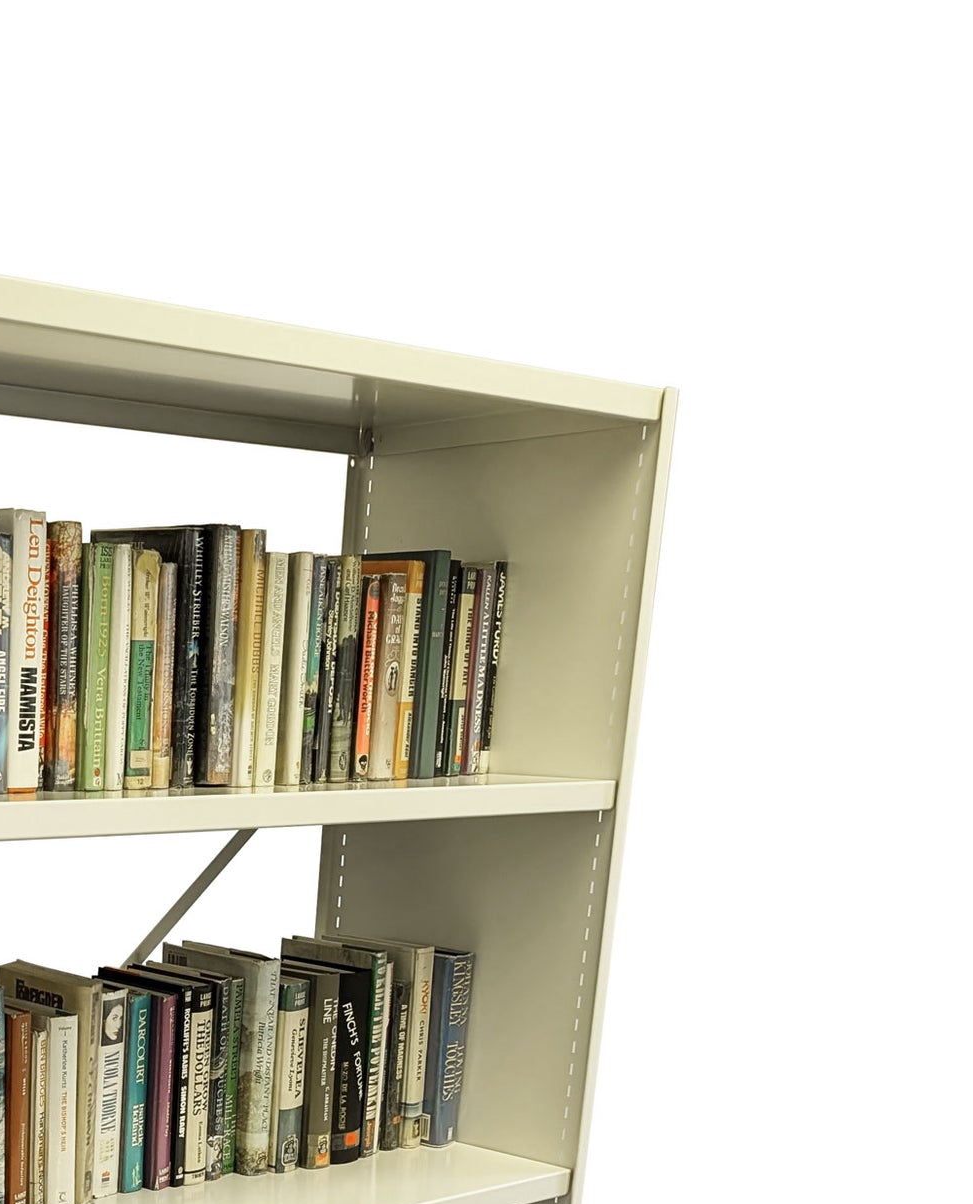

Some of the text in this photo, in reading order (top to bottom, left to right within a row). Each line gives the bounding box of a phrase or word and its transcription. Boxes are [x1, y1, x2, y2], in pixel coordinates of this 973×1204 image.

[3, 553, 11, 615] ANDREW
[23, 518, 44, 660] Len Deighton
[61, 585, 70, 629] DAUGHTER
[98, 575, 111, 657] Born 1925
[191, 536, 204, 638] WHITLEY STRIEBER
[271, 558, 285, 657] MEN AND ANGELS
[495, 572, 506, 618] JAMES
[60, 647, 68, 666] THE
[68, 584, 80, 697] PHYLLIS WHITNEY
[219, 608, 230, 646] WATSON
[474, 575, 492, 733] KALLEN LITTLE MADNESS
[361, 611, 374, 713] Michael Butterworth
[18, 667, 38, 752] MAMISTA
[92, 668, 107, 768] Vera Brittain
[136, 680, 144, 720] Testament
[188, 688, 198, 730] FORBIDDEN
[265, 664, 280, 746] MARY GORDON
[230, 983, 243, 1081] PAMELA STREET
[322, 998, 332, 1024] LINE
[342, 1002, 359, 1045] FINCH'S
[442, 960, 466, 1101] KINGSLEY TOUCHES
[135, 1008, 146, 1085] DARCOURT
[181, 1055, 189, 1079] BABIES
[193, 1019, 206, 1116] THE DOLLARS
[254, 1021, 266, 1084] Patricia Wright
[287, 1029, 297, 1092] Genevieve Lyons
[294, 1018, 305, 1099] SLIEVELEA
[396, 1042, 405, 1080] MADNESS
[416, 1049, 424, 1082] PARKER
[100, 1051, 120, 1133] NICOLA THORNE
[179, 1086, 187, 1114] SIMON
[131, 1104, 139, 1146] Holland
[137, 1103, 145, 1146] Isabelle
[223, 1094, 234, 1160] MILL-RACE
